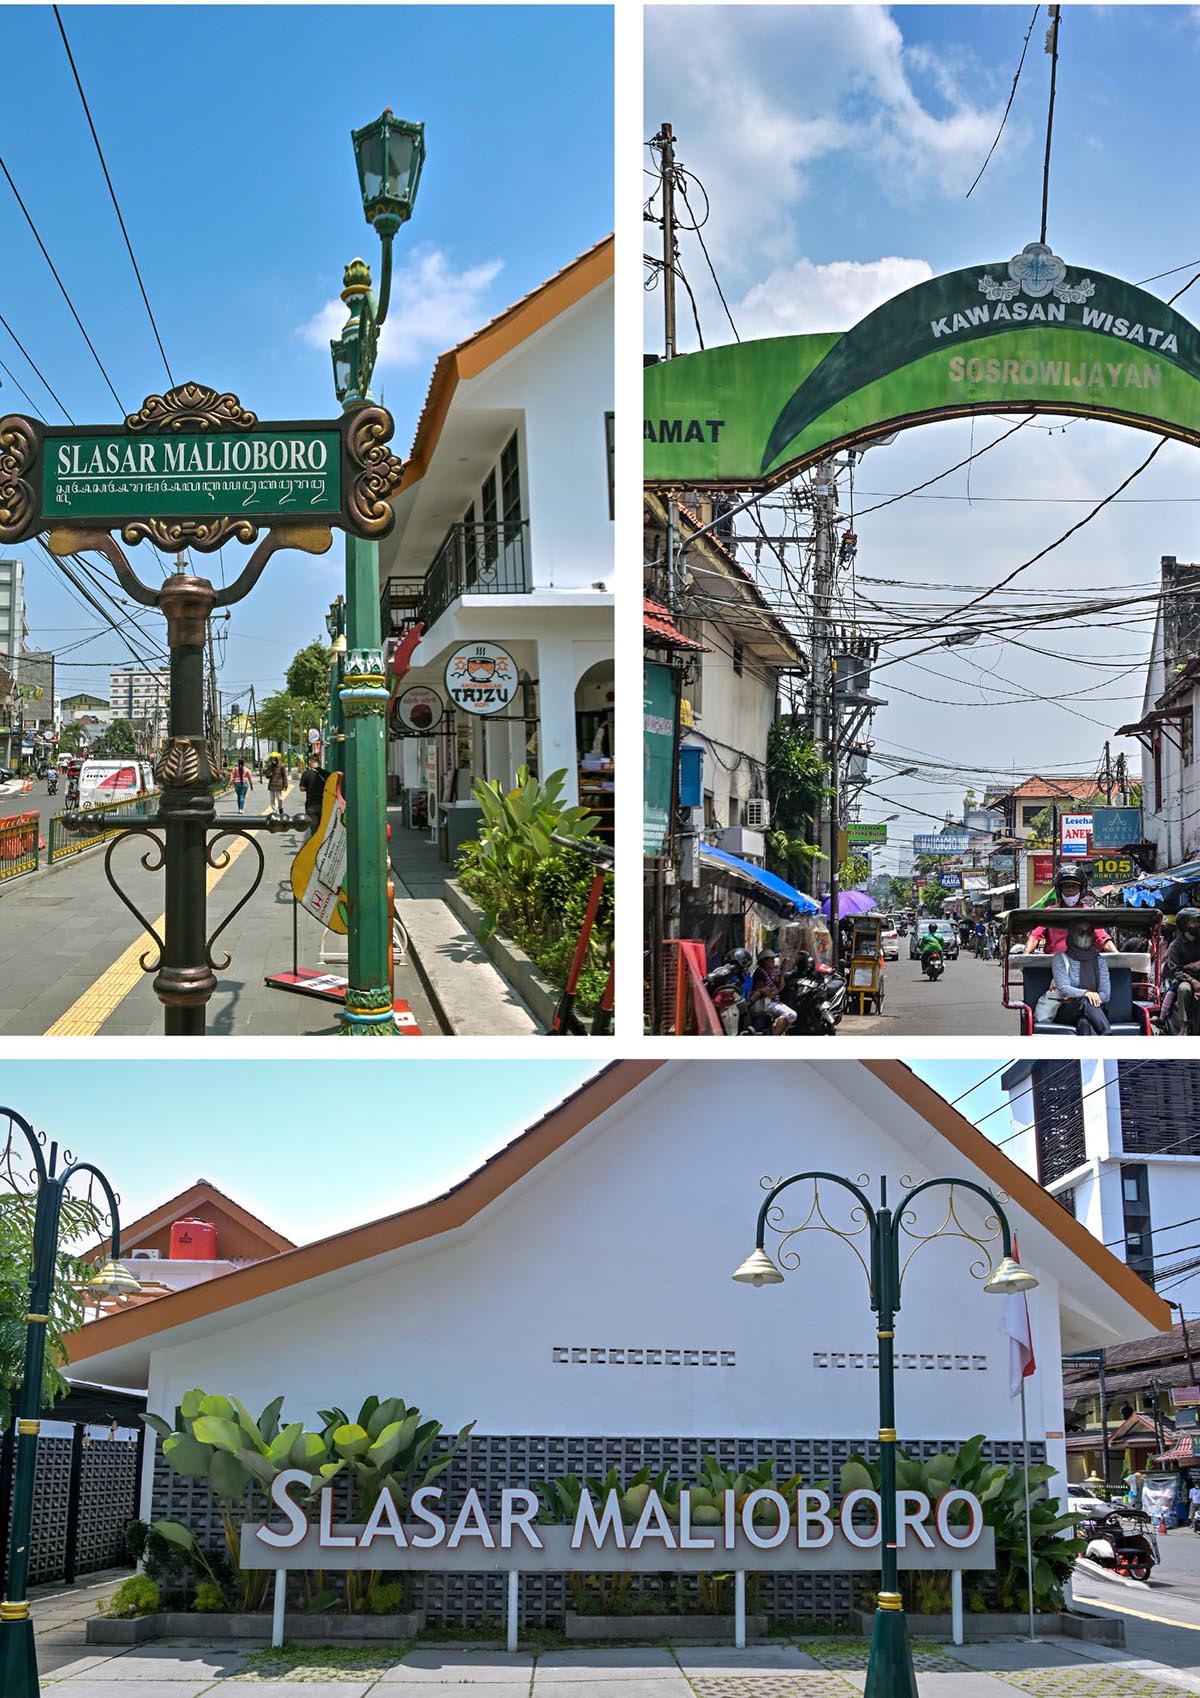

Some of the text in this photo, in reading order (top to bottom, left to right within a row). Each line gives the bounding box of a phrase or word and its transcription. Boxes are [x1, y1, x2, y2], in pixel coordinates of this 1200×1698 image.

[931, 302, 1178, 353] KAWASAN WISATA
[948, 356, 1161, 388] SOSROWIJAYAN
[57, 439, 327, 475] SLASAR MALIOBORO
[1094, 860, 1131, 873] 105
[255, 1468, 984, 1550] SLASAR MALIOBORO
